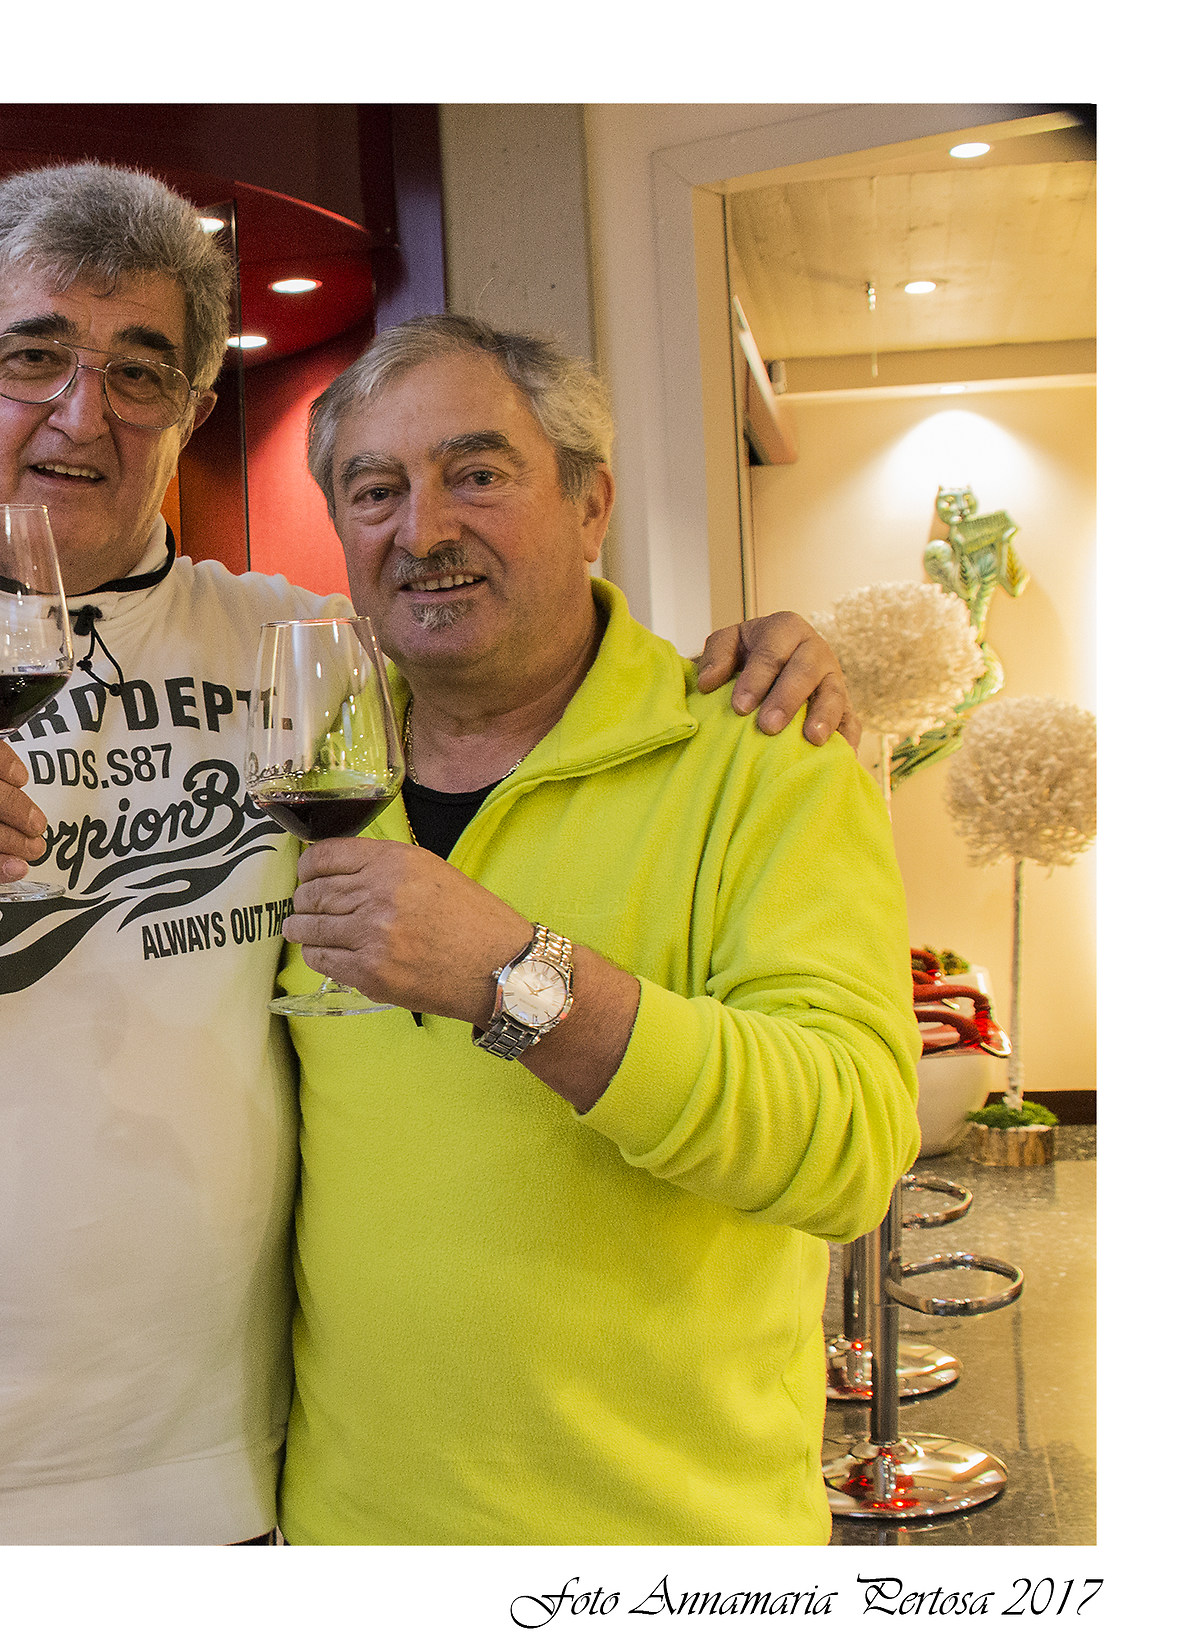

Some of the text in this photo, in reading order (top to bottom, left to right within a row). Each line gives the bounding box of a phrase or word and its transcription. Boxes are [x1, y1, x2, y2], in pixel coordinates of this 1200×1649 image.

[27, 742, 173, 790] DDS.S87
[141, 910, 227, 961] ALWAYS
[230, 904, 263, 945] OUT
